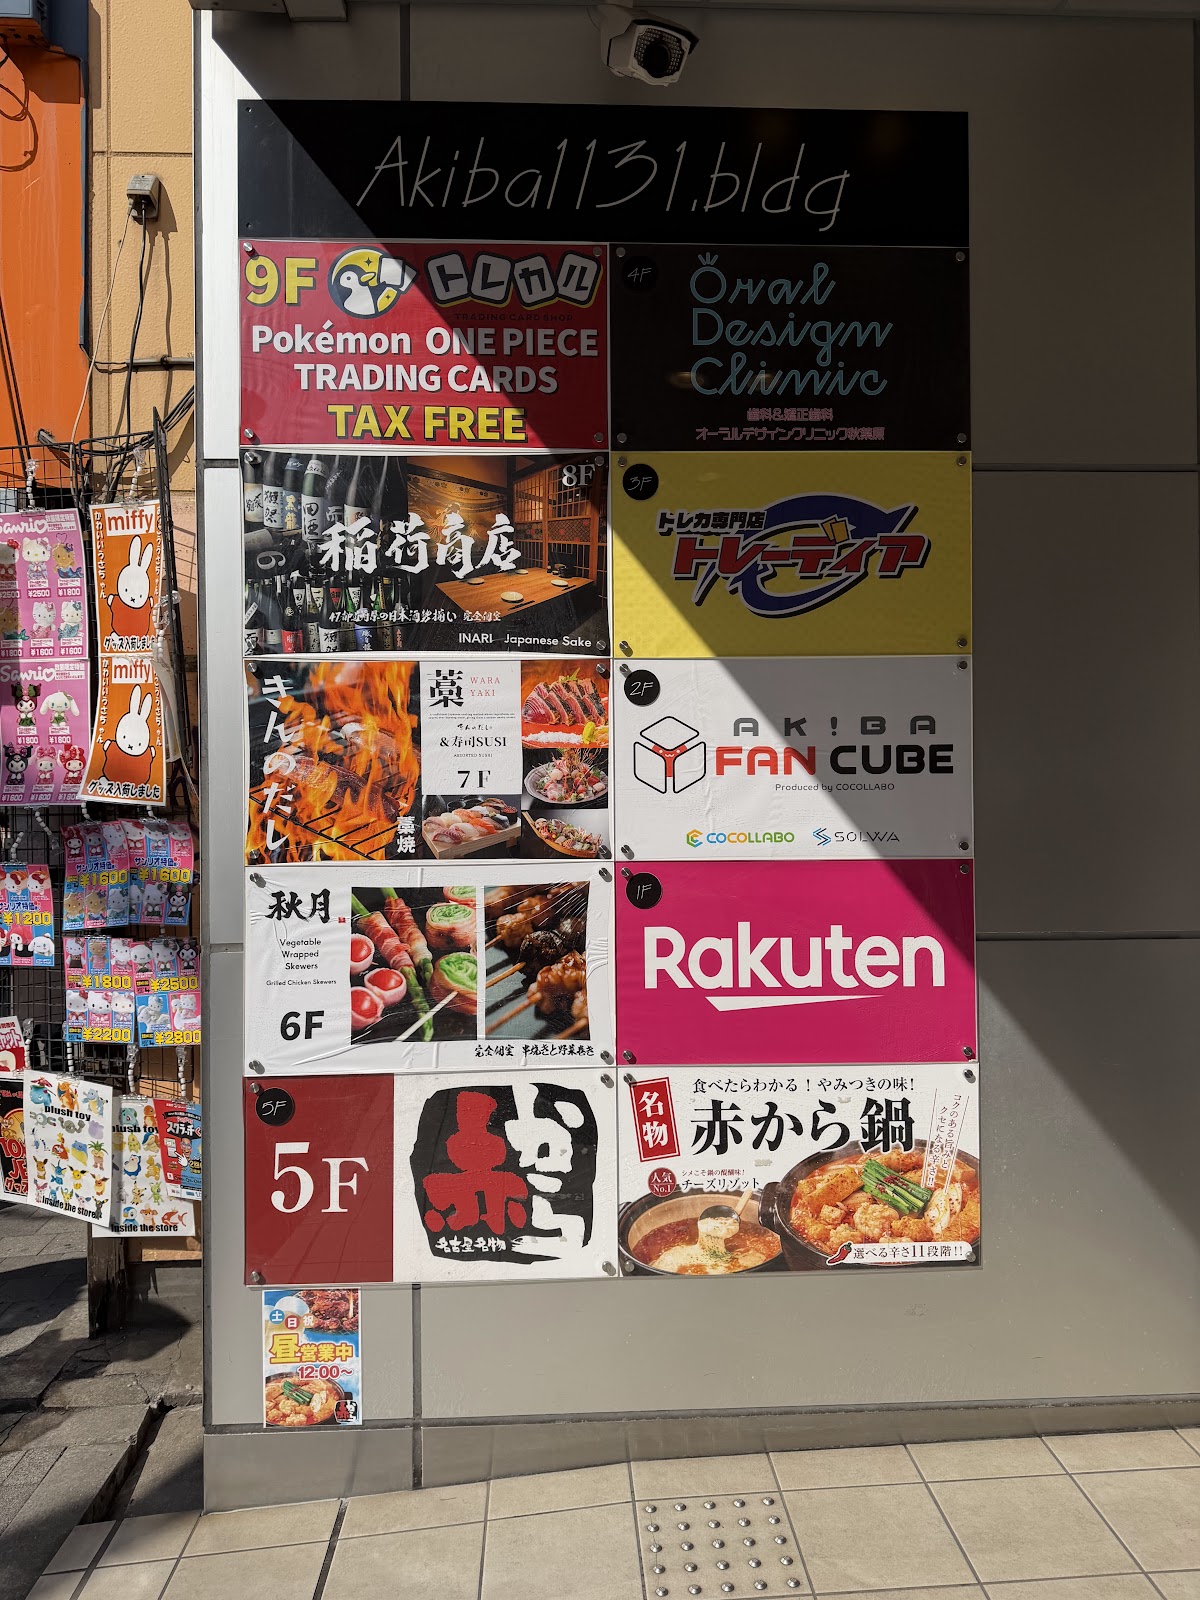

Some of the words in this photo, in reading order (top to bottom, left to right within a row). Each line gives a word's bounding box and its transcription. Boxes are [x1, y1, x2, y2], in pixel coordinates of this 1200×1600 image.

[356, 136, 850, 232] Akiba1131.bldg
[245, 255, 318, 306] 9F
[432, 256, 597, 303] トレカル
[627, 267, 651, 282] 4F
[690, 252, 836, 305] Oral
[456, 313, 505, 321] TRADING
[509, 313, 541, 321] CARD
[543, 314, 573, 322] SHOP
[253, 320, 410, 354] Pokémon
[426, 326, 505, 356] ONE
[507, 328, 599, 357] PIECE
[692, 308, 893, 366] Design
[294, 364, 446, 393] TRADING
[447, 366, 559, 394] CARDS
[690, 352, 888, 395] Clinic
[327, 404, 412, 439] TAX
[424, 406, 528, 442] FREE
[747, 407, 834, 422] 歯科&矯正歯科
[695, 427, 886, 441] オーラルデザインクリニック秋葉原
[561, 464, 596, 487] 8F
[628, 476, 653, 492] 3F
[108, 509, 153, 533] miffy
[658, 512, 767, 531] トレカ専門店
[318, 512, 522, 580] 稲荷商店
[672, 535, 929, 577] トレーディア
[462, 611, 503, 623] 完全個室
[458, 632, 494, 644] INARI
[504, 634, 559, 648] Japanese
[562, 635, 592, 648] Sake
[114, 660, 150, 683] miffy
[426, 669, 465, 708] 藁
[470, 676, 501, 685] WARA
[629, 680, 654, 697] 2F
[470, 689, 496, 697] YAKI
[262, 674, 298, 851] きんのだし
[715, 746, 817, 776] FAN
[829, 744, 954, 775] CUBE
[88, 781, 160, 798] グッズ入荷しました
[775, 783, 819, 792] Produced
[822, 783, 834, 793] by
[836, 783, 896, 791] COCOLLABO
[396, 815, 416, 854] 藁焼
[706, 831, 795, 844] COCOLLABO
[834, 830, 900, 842] SOLWA
[80, 870, 128, 887] ¥1600
[139, 867, 190, 883] ¥1600
[636, 883, 653, 900] 1F
[265, 888, 332, 924] 秋月
[3, 911, 51, 925] ¥1200
[280, 938, 322, 947] Vegetable
[282, 951, 319, 961] Wrapped
[644, 921, 946, 990] Rakuten
[285, 962, 318, 970] Skewers
[82, 975, 131, 989] ¥1800
[150, 976, 198, 992] ¥2500
[266, 979, 286, 987] Grilled
[280, 1010, 325, 1041] 6F
[83, 1027, 131, 1042] ¥2200
[154, 1031, 201, 1045] ¥2800
[474, 1044, 515, 1058] 完全個室
[522, 1043, 595, 1058] 串焼きと野菜巻き
[45, 1105, 73, 1117] plush
[75, 1111, 91, 1121] toy
[262, 1099, 287, 1116] 5F
[639, 1091, 669, 1149] 名物
[690, 1097, 915, 1156] 赤から鍋
[941, 1094, 962, 1169] コクのある旨みと
[271, 1141, 369, 1213] 5F
[651, 1172, 673, 1183] 人気
[681, 1178, 760, 1191] チーズリゾット
[653, 1184, 671, 1194] No.1
[42, 1195, 64, 1208] Inside
[65, 1201, 76, 1213] the
[111, 1223, 138, 1232] Inside
[139, 1223, 153, 1232] the
[435, 1235, 507, 1253] 名古屋名物
[269, 1333, 354, 1364] 昼営業中
